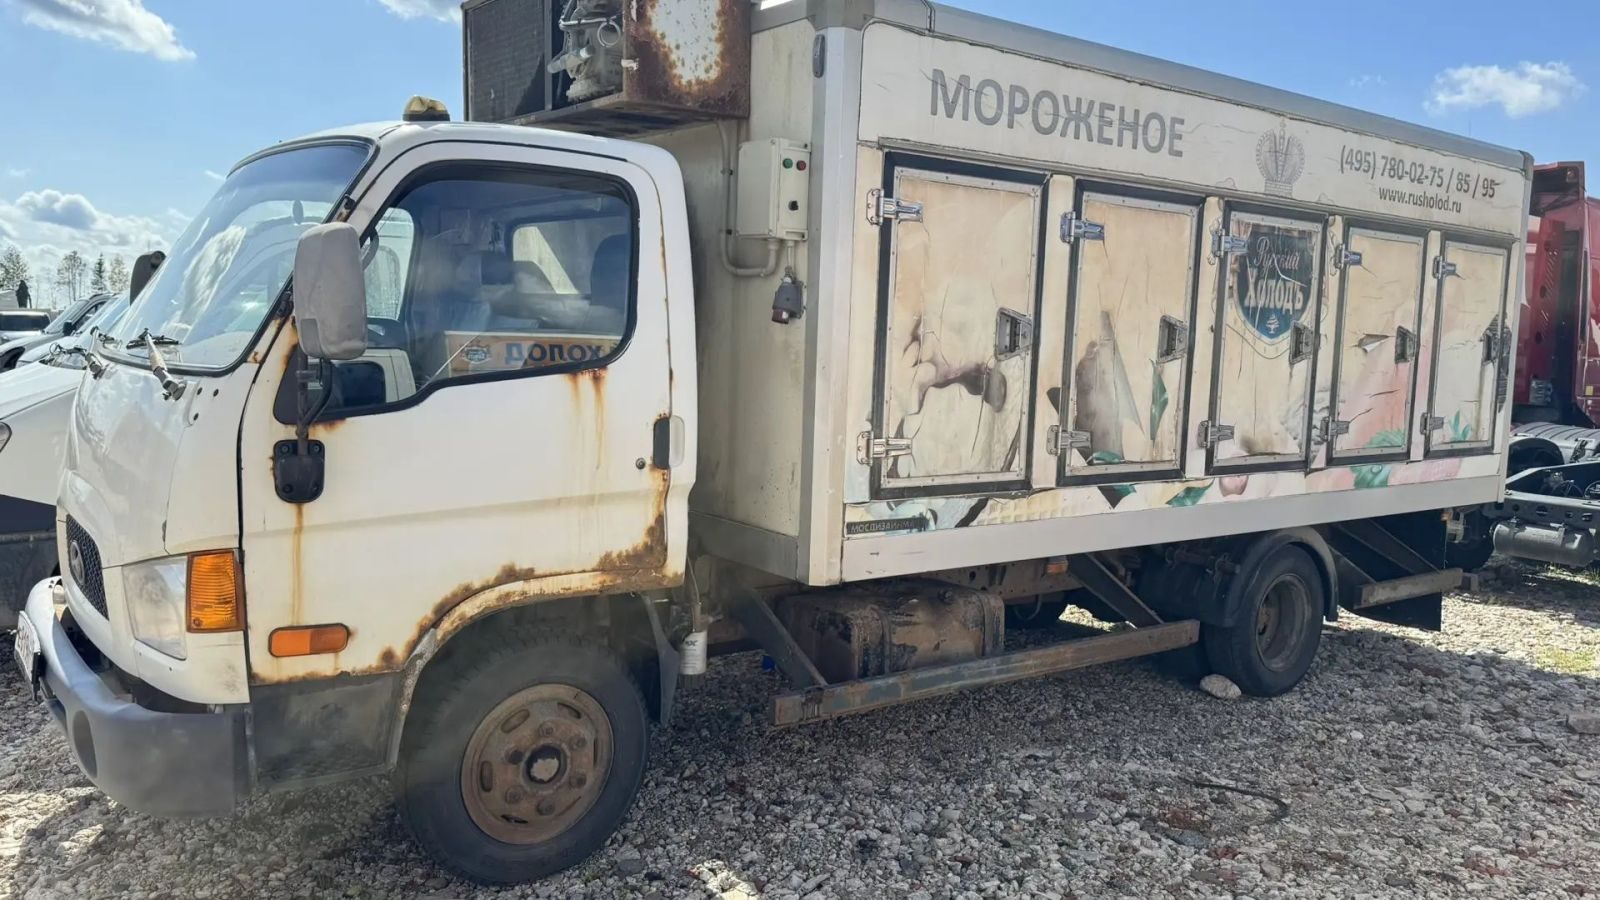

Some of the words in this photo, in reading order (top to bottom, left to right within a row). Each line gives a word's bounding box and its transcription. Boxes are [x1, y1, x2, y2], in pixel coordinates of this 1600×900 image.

[930, 68, 1185, 157] МОРОЖЕНОЕ
[1340, 145, 1376, 180] (495)
[1381, 155, 1444, 188] 780-02-75
[1456, 172, 1471, 193] 85
[1482, 178, 1496, 198] 95
[1379, 187, 1462, 213] www.rusholod.ru
